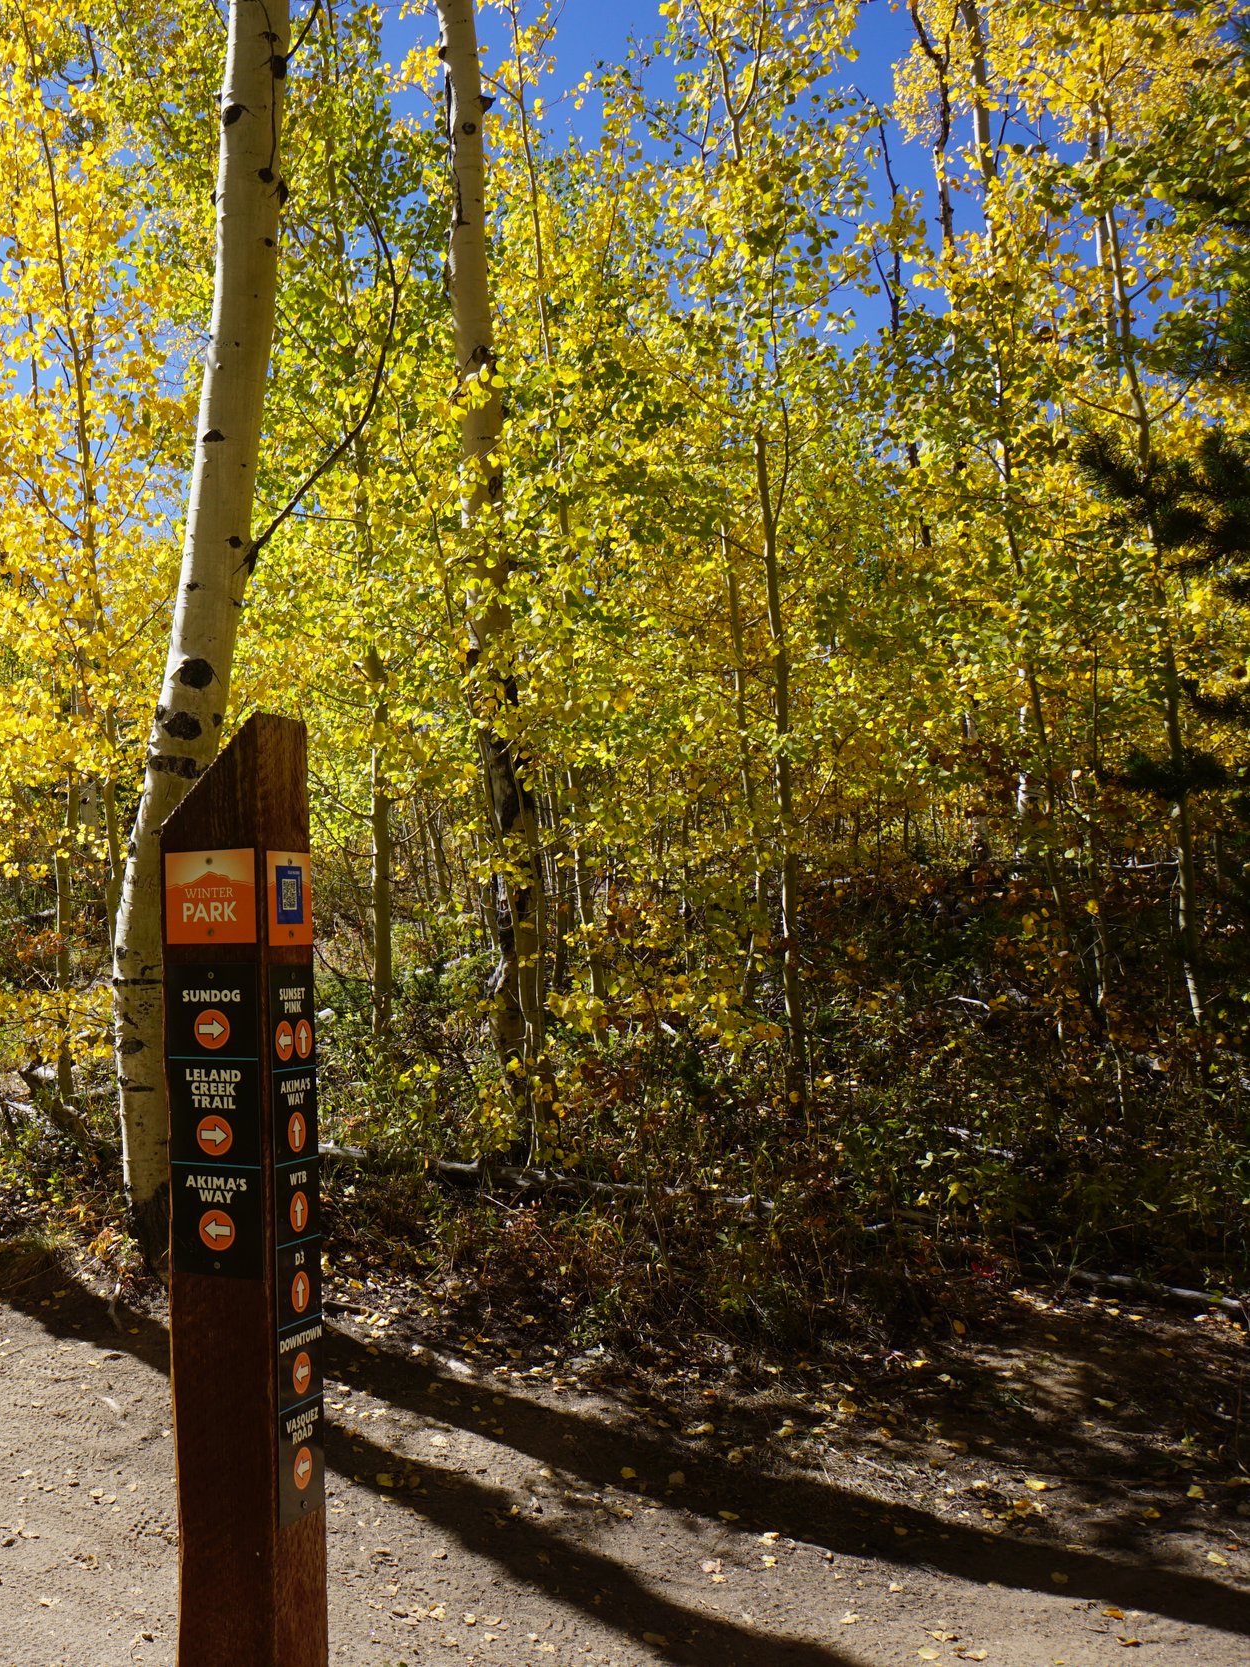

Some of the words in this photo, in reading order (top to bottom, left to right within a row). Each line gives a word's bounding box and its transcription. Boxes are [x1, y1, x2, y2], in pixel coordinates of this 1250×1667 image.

[185, 887, 234, 899] WINTER
[182, 901, 237, 923] PARK
[182, 989, 241, 1003] SUNDOG
[279, 987, 306, 1001] SUNSET
[284, 1001, 302, 1014] PINK
[185, 1068, 242, 1082] LELAND
[191, 1082, 236, 1096] CREEK
[280, 1077, 311, 1094] AKIMA'S
[192, 1095, 236, 1109] TRAIL
[287, 1091, 305, 1106] WAY
[185, 1175, 247, 1191] AKIMA'S
[290, 1171, 307, 1186] WTB
[199, 1189, 234, 1204] WAY
[295, 1250, 305, 1266] D3
[280, 1325, 322, 1353] DOWNTOWN
[286, 1407, 319, 1433] VASQUEZ
[292, 1424, 313, 1445] ROAD
